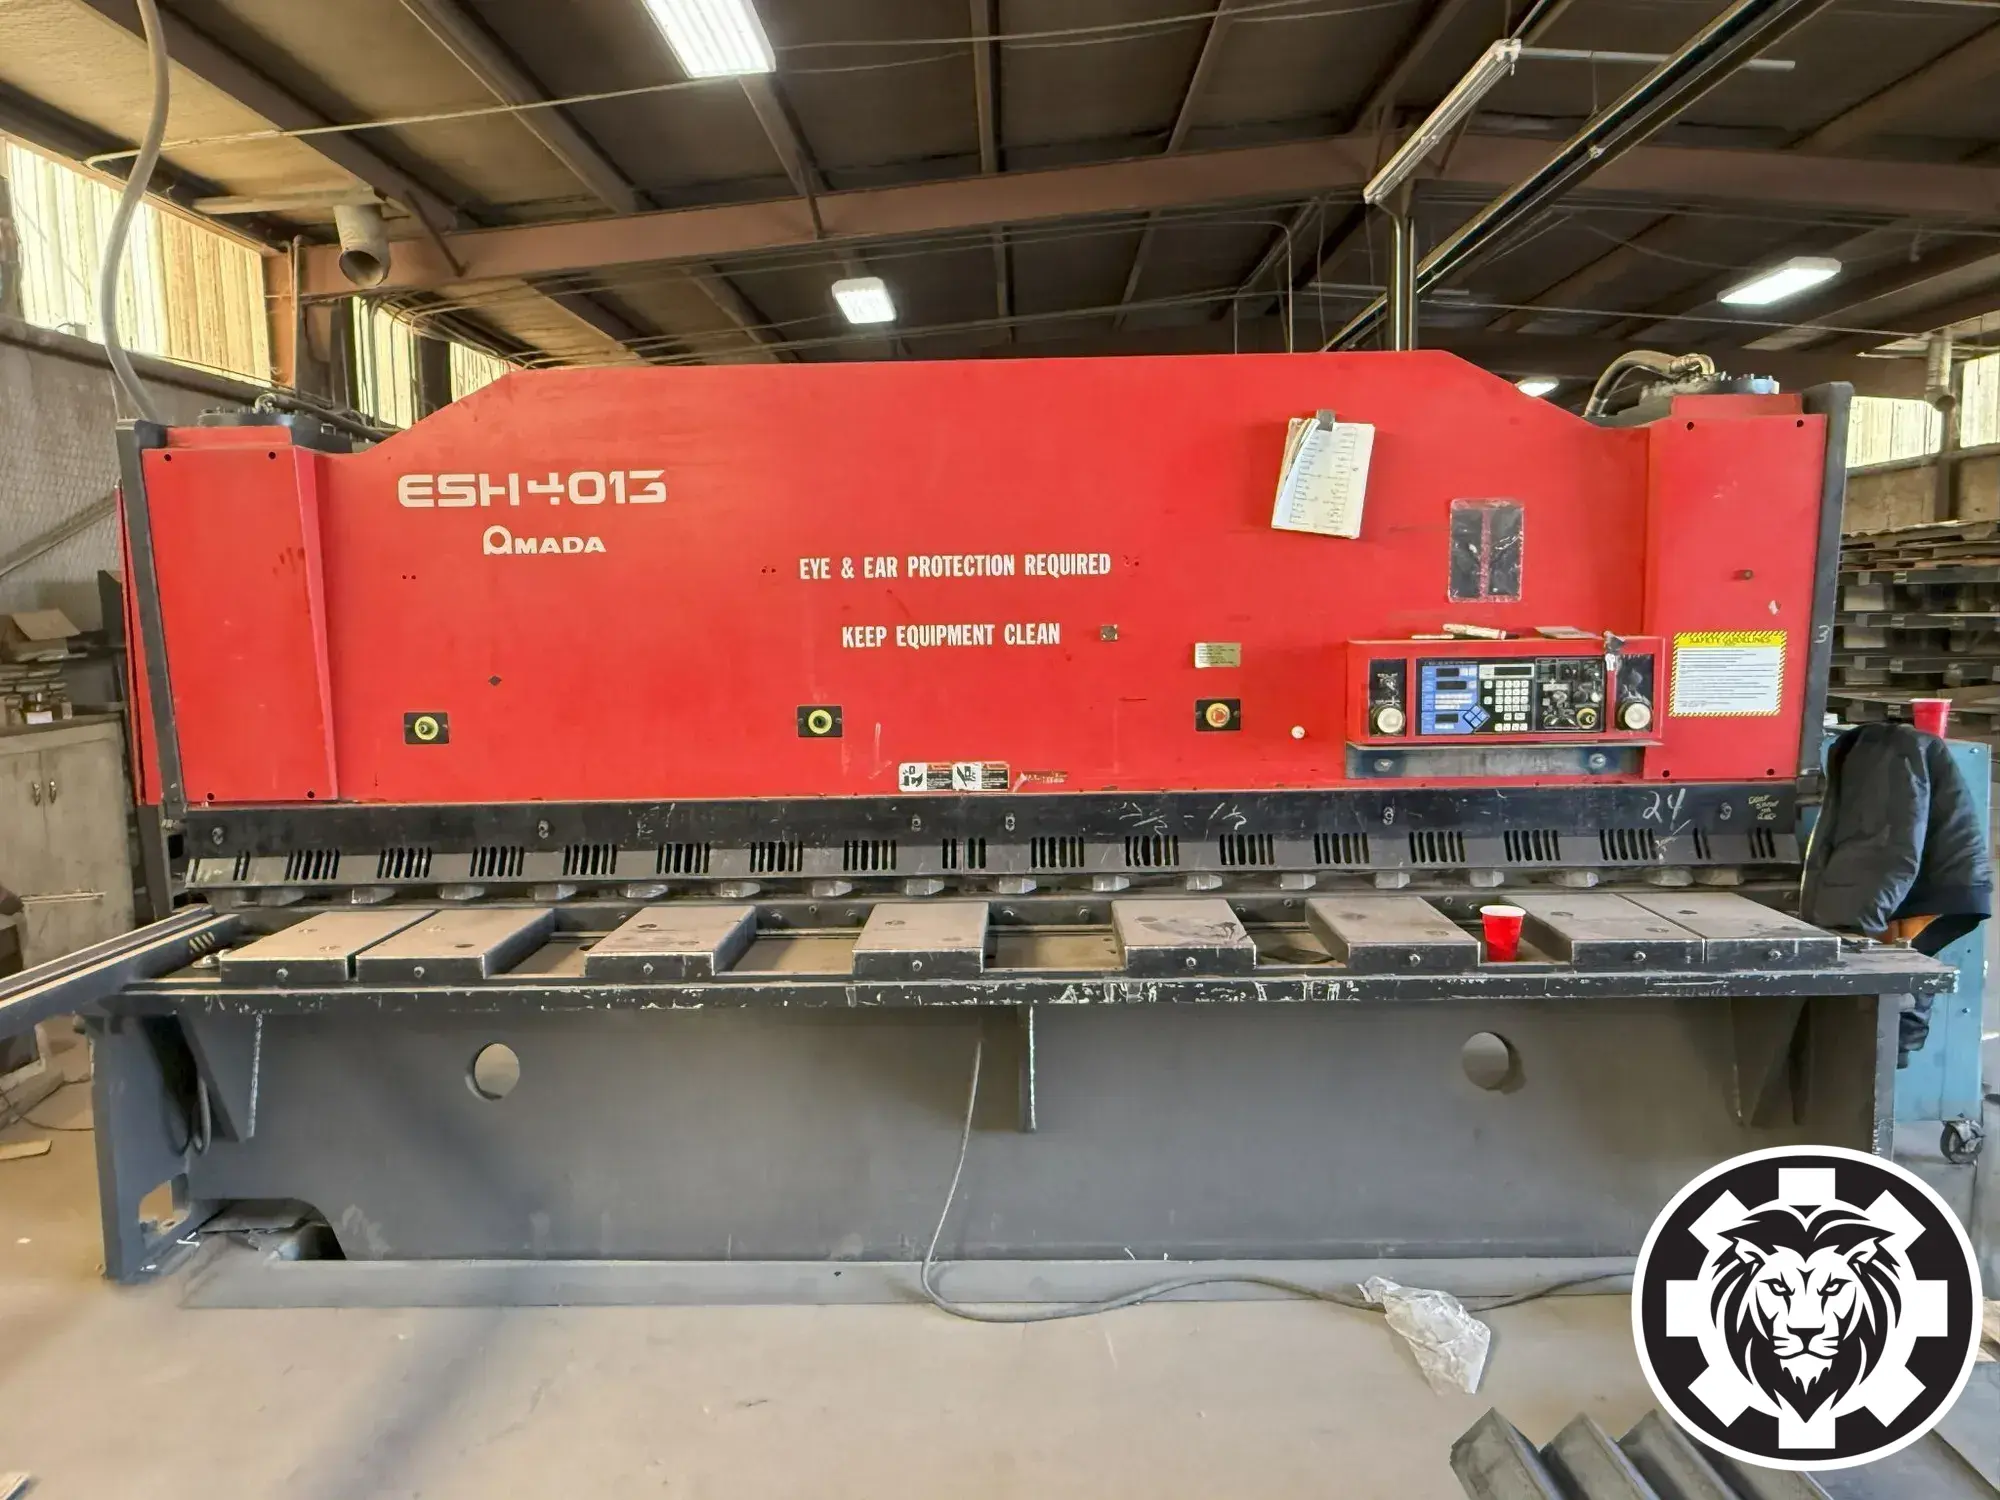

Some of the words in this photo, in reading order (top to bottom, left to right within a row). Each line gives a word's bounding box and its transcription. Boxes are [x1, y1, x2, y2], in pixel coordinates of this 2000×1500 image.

[483, 525, 607, 555] AMADA
[799, 557, 830, 580] EYE
[841, 557, 855, 578] &
[864, 556, 898, 579] EAR
[908, 554, 1015, 578] PROTECTION
[1025, 553, 1111, 578] REQUIRED
[842, 625, 887, 648] KEEP
[896, 624, 995, 650] EQUIPMENT
[1004, 623, 1060, 646] CLEAN
[1813, 624, 1831, 644] 3
[1641, 788, 1687, 831] 24
